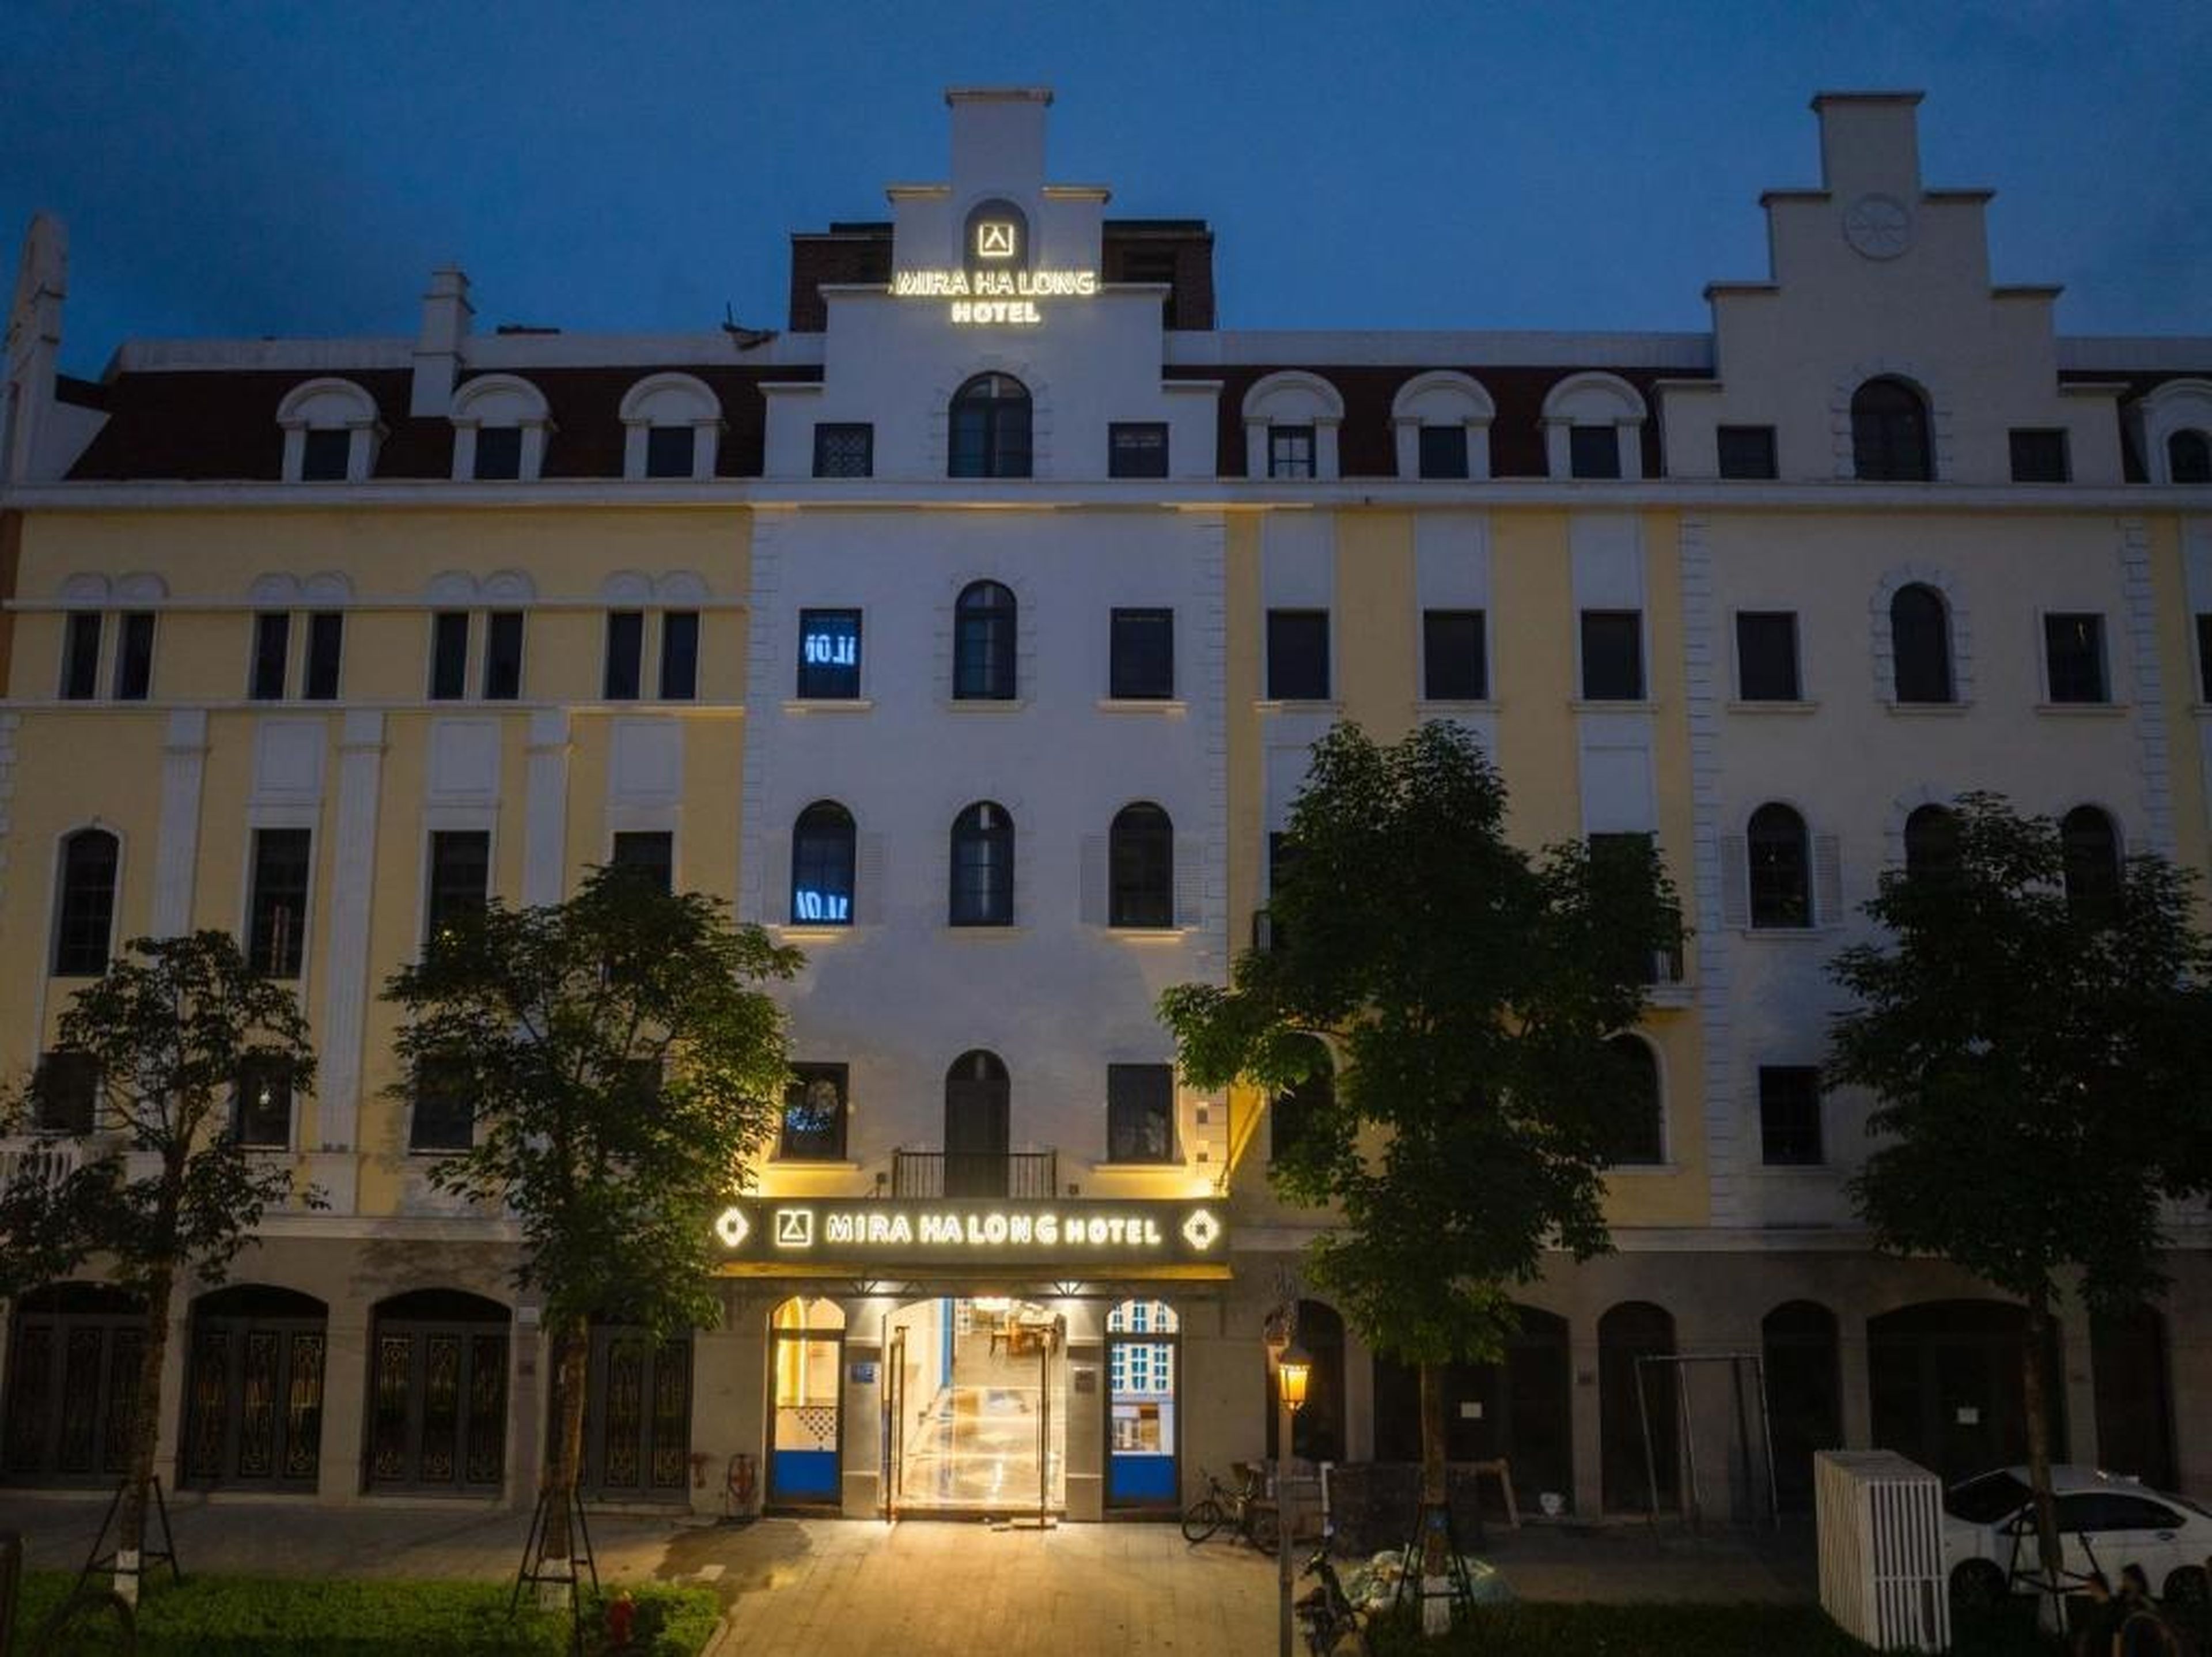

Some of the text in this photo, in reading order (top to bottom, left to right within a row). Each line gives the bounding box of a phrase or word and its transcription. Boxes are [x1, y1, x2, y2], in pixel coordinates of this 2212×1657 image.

[895, 271, 1097, 296] MIRA HA LONG
[950, 301, 1041, 324] HOTEL
[826, 1213, 1161, 1245] MIRA HA LONG HOTEL
